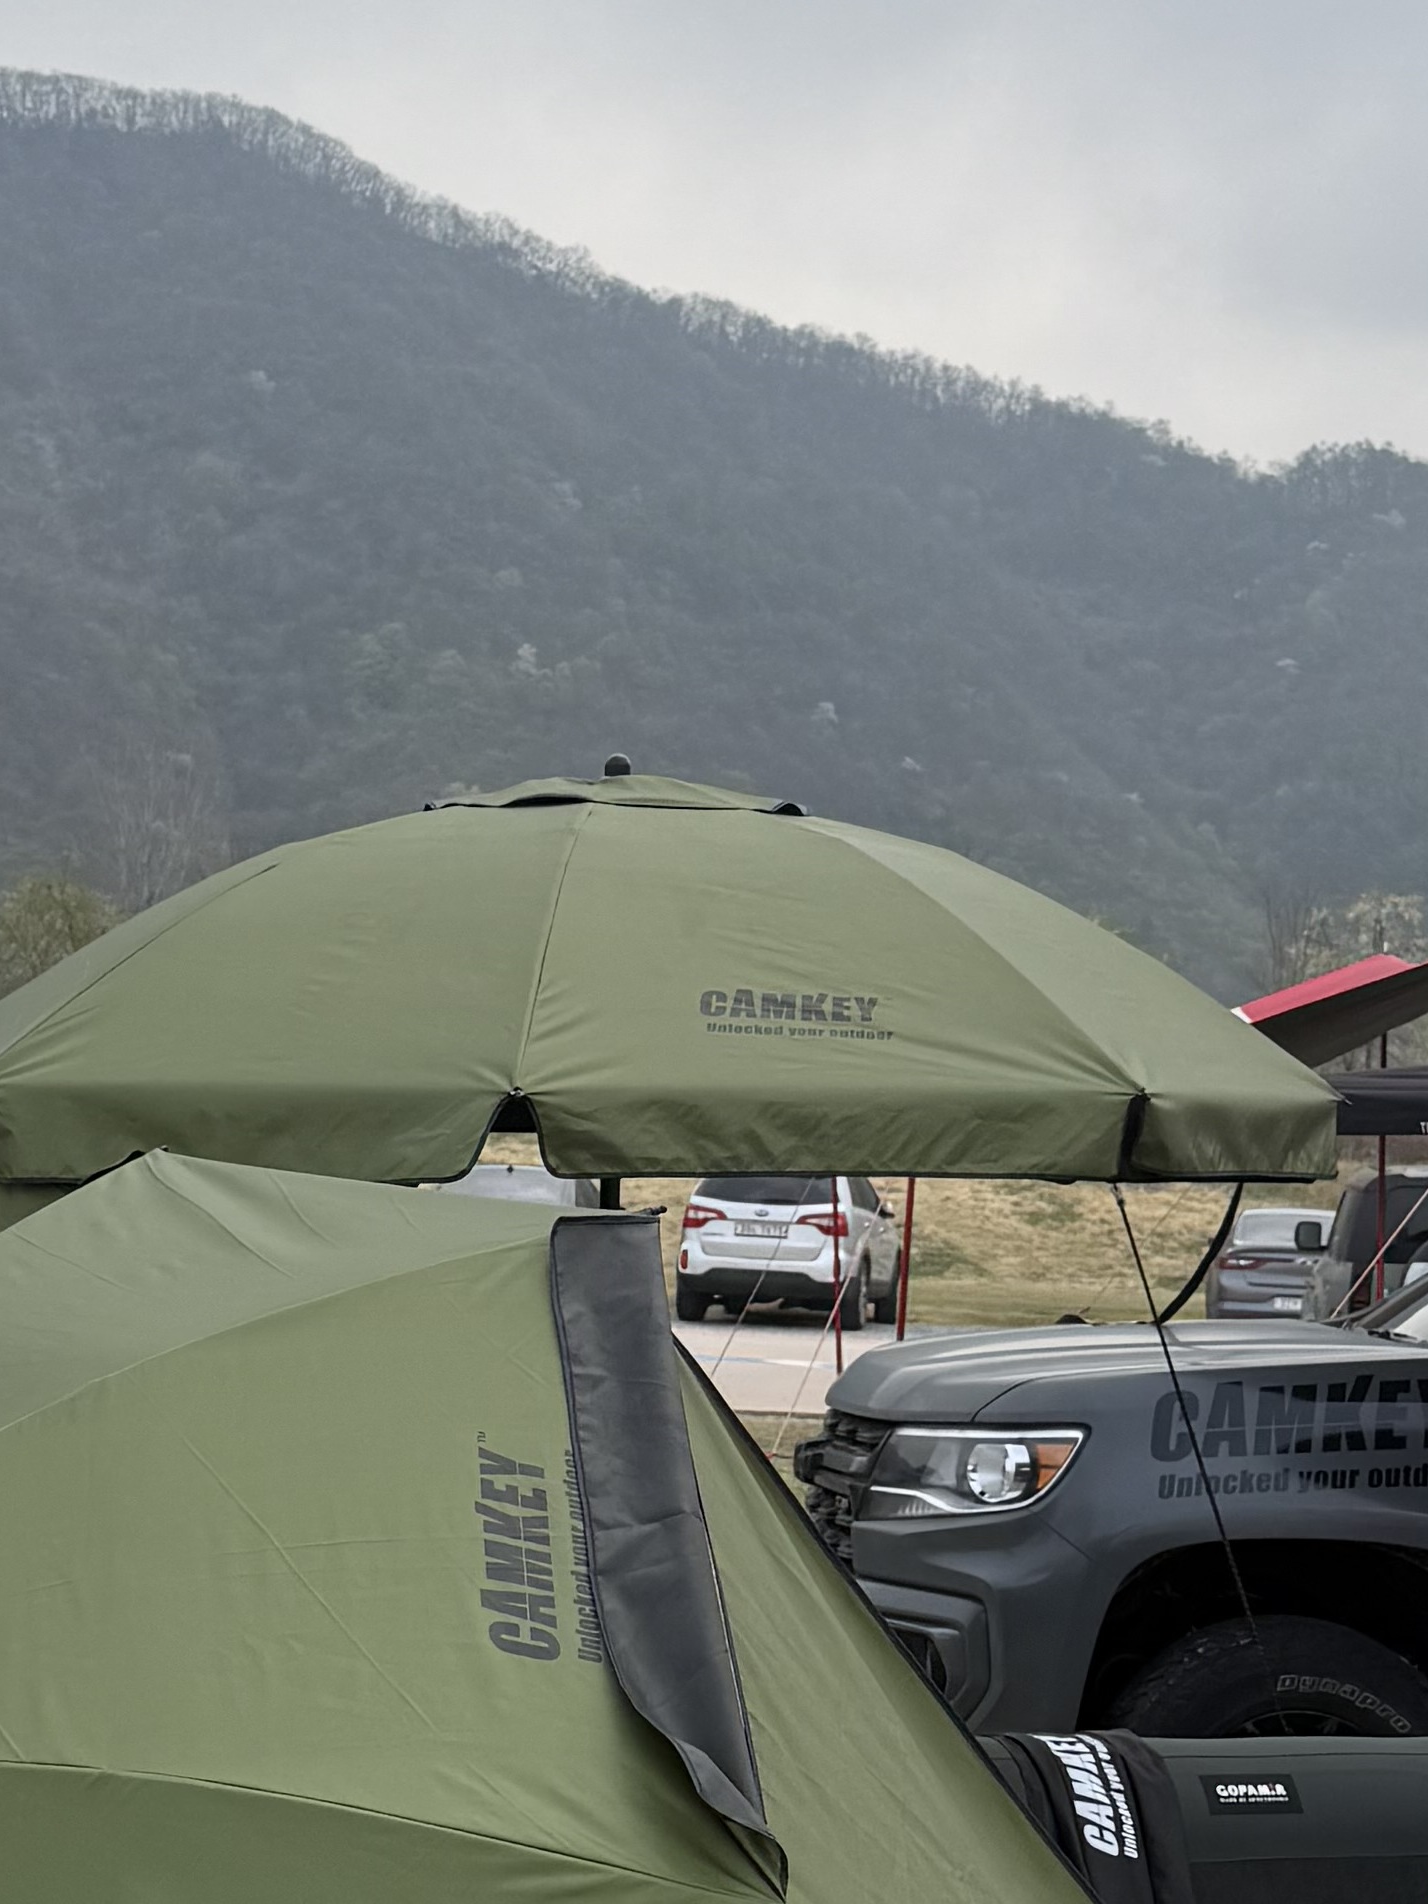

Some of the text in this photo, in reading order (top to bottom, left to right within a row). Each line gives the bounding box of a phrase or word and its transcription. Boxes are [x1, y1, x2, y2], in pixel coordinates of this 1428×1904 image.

[699, 989, 879, 1023] CAMKEY
[706, 1022, 894, 1040] Unlocked your outdoor
[1158, 1468, 1290, 1499] Unlocked
[1298, 1469, 1360, 1494] your
[474, 1447, 560, 1661] CAMKEY
[1276, 1674, 1412, 1733] Dynapro
